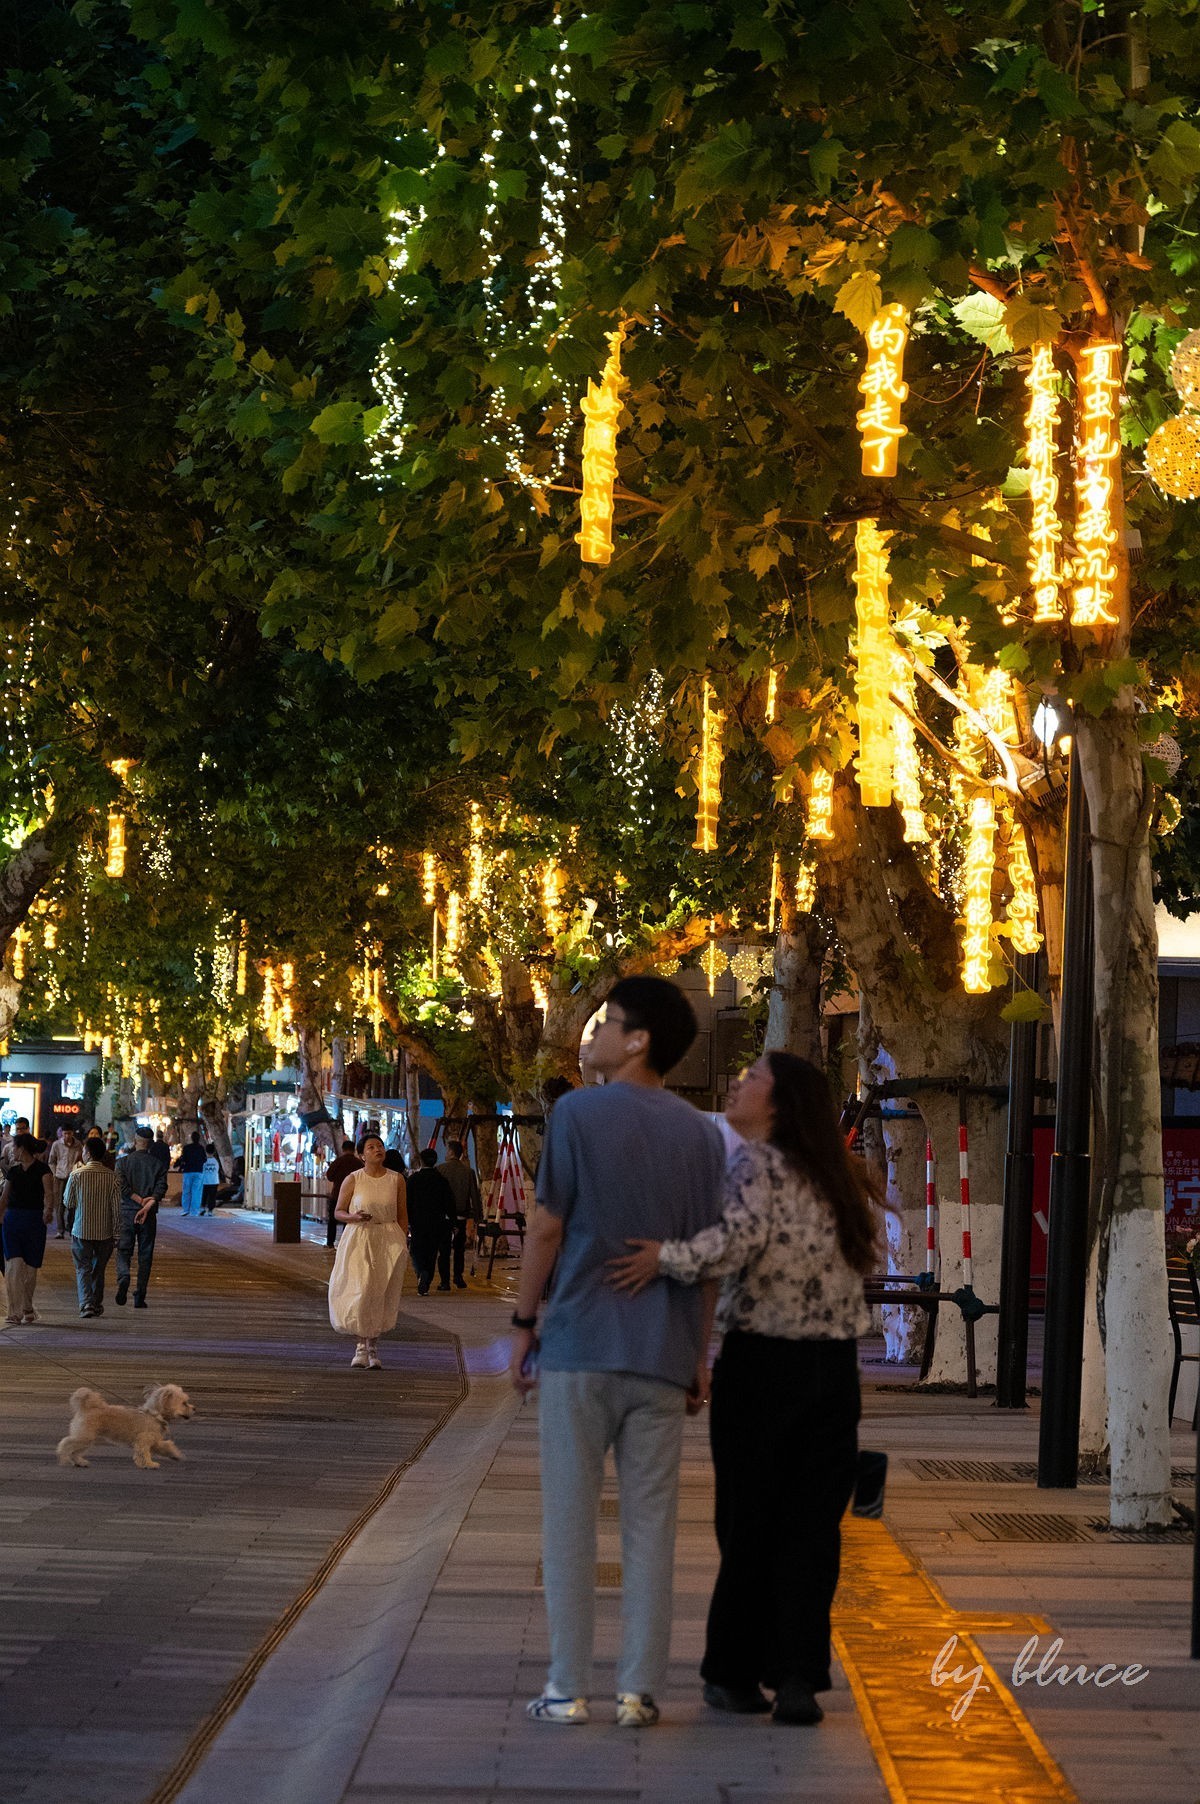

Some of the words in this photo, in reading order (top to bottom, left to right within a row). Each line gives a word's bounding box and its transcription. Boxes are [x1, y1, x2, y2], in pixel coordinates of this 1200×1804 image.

[859, 304, 907, 474] 的我走了
[1071, 343, 1122, 626] 夏虫也为我沉默
[53, 1104, 80, 1114] MIDO
